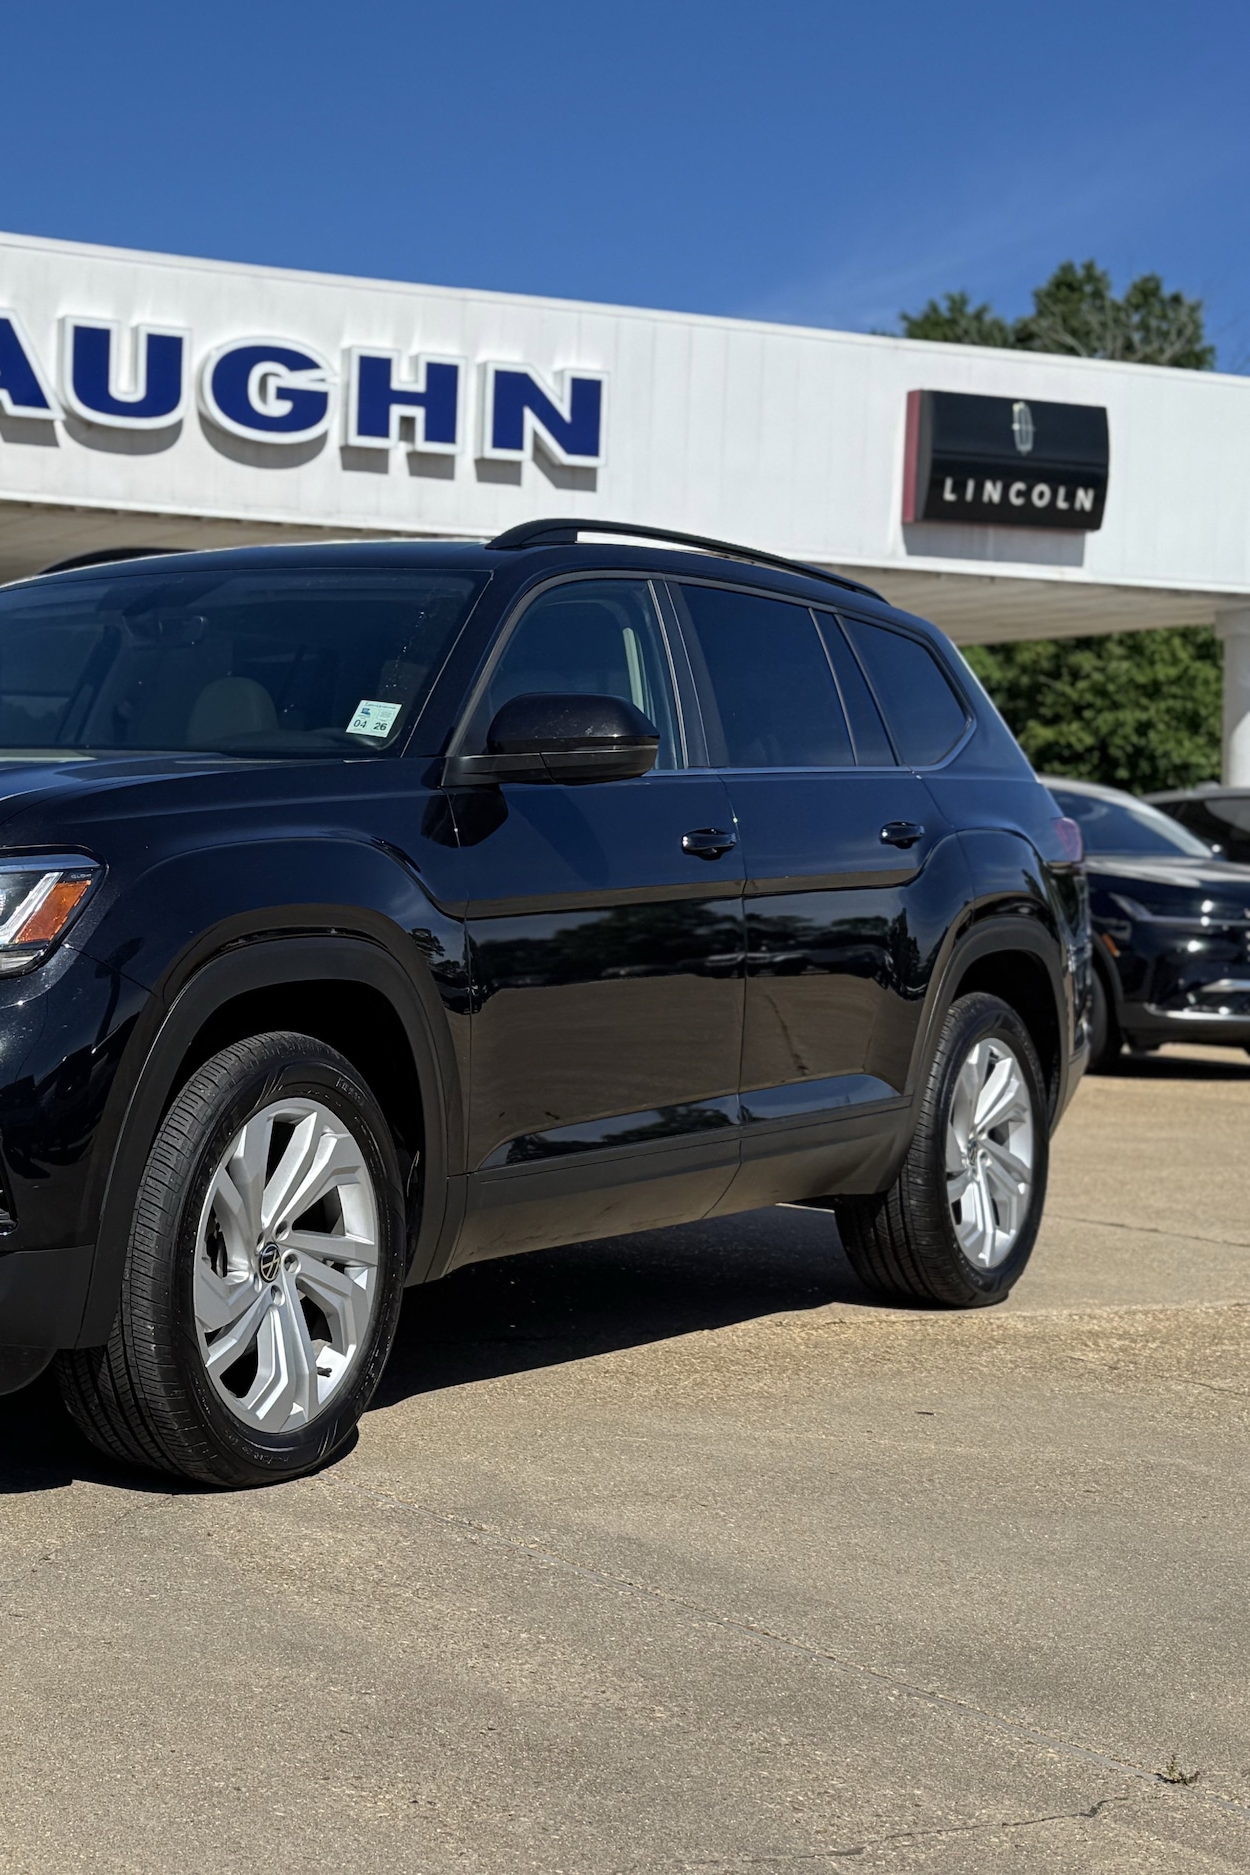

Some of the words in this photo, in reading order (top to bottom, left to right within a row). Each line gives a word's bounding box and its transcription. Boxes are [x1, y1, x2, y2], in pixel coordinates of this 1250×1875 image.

[943, 477, 1095, 512] LINCOLN
[353, 719, 367, 729] 04
[373, 722, 388, 731] 26
